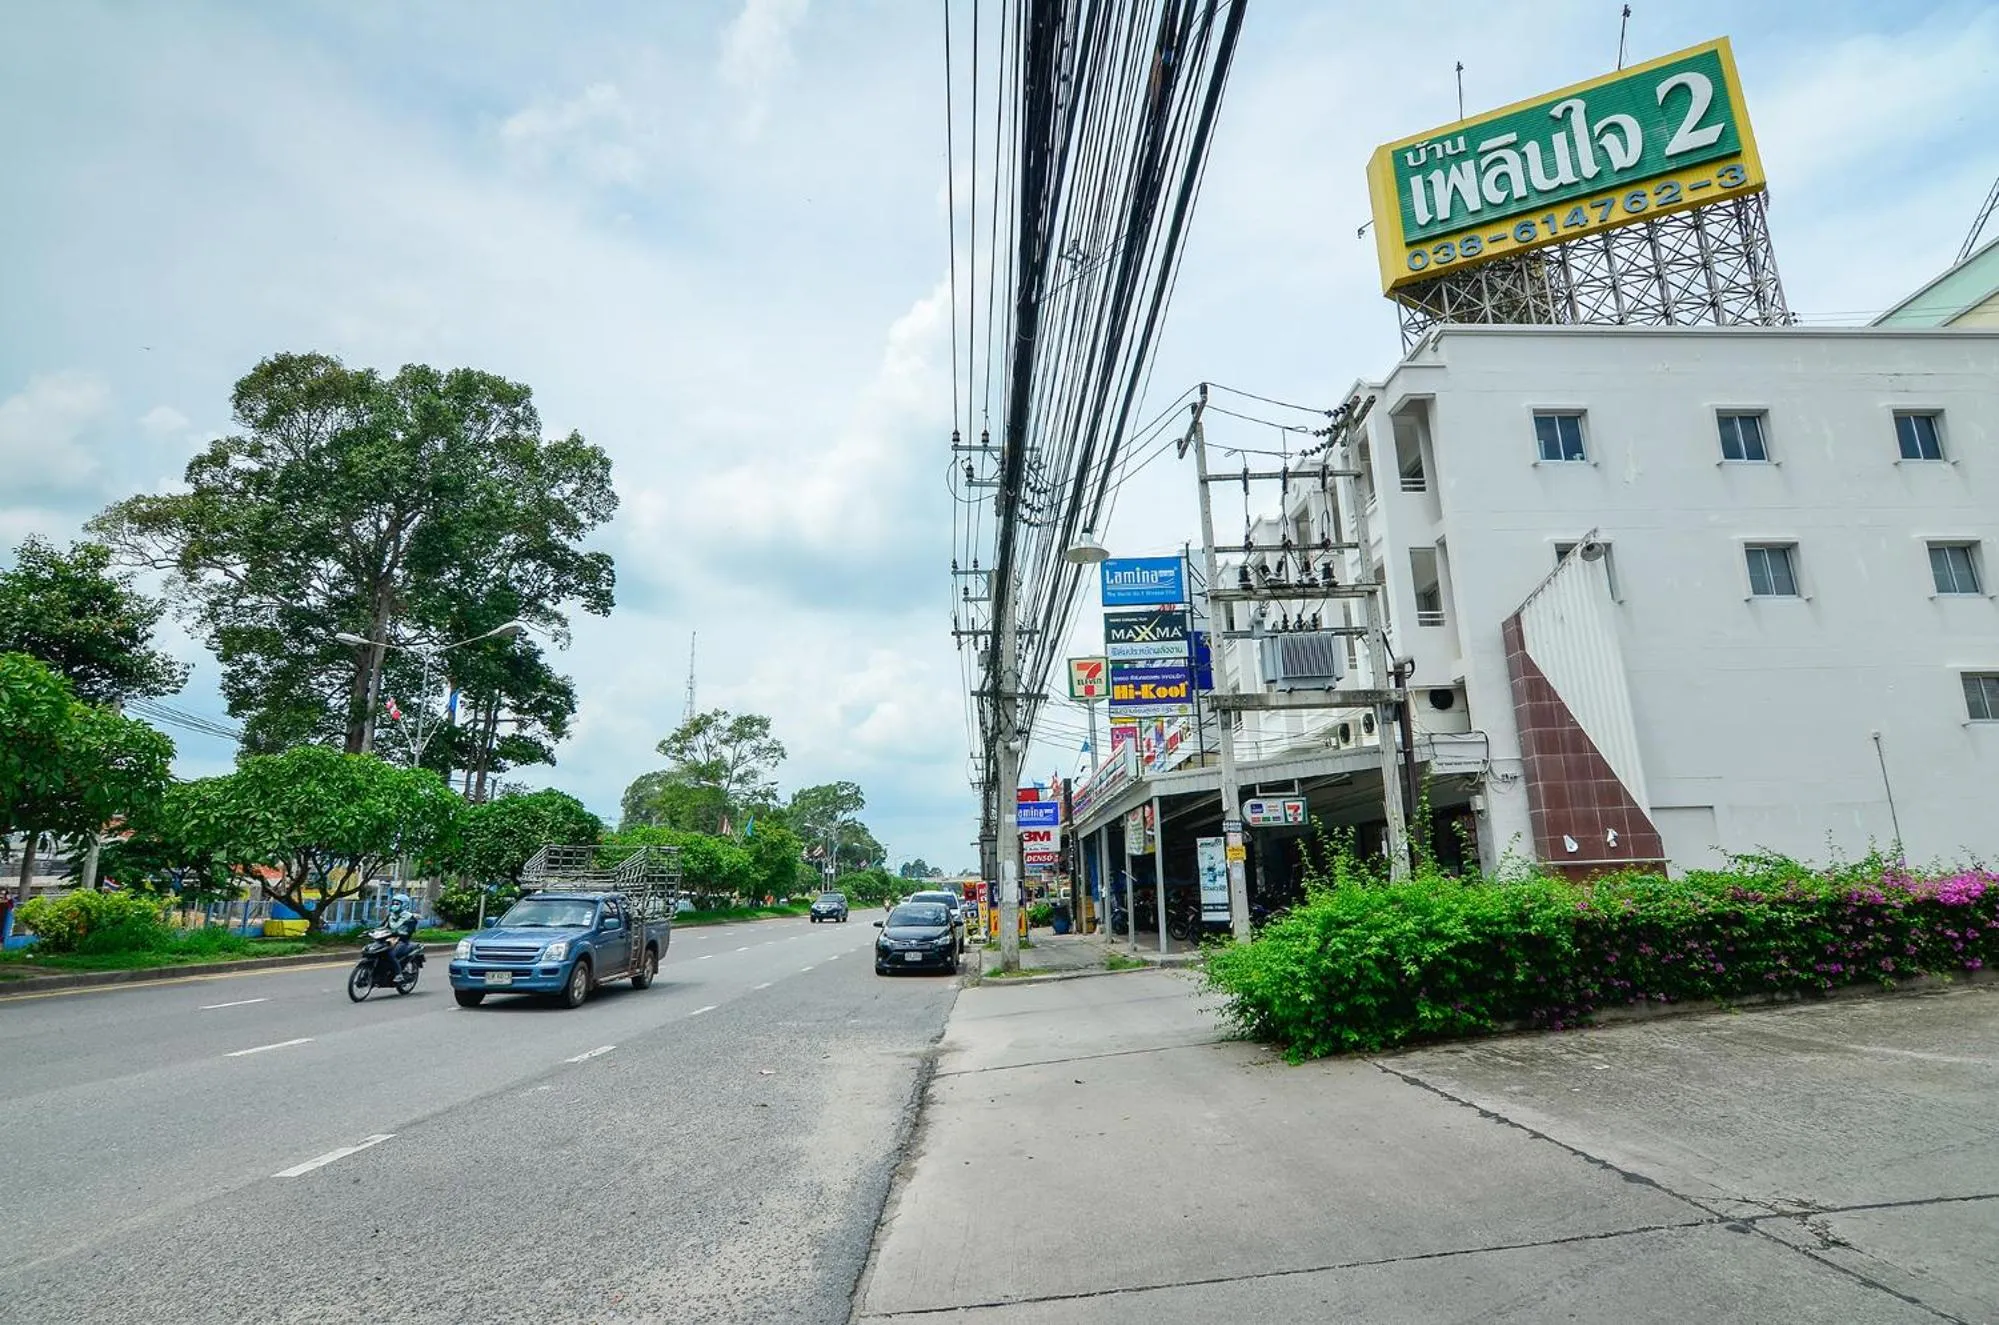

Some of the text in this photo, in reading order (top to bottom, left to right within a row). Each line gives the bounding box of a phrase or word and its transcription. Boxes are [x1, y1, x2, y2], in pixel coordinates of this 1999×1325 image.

[1404, 135, 1468, 168] บ้าน
[1409, 71, 1726, 228] เพลินใจ 2
[1407, 163, 1748, 272] 038-614762-3
[1105, 567, 1159, 585] Lamina
[1076, 662, 1102, 679] 7
[1113, 683, 1188, 700] Hi-Kool
[1017, 806, 1044, 818] amina
[1023, 831, 1051, 842] 3M
[1026, 853, 1054, 863] DENSO
